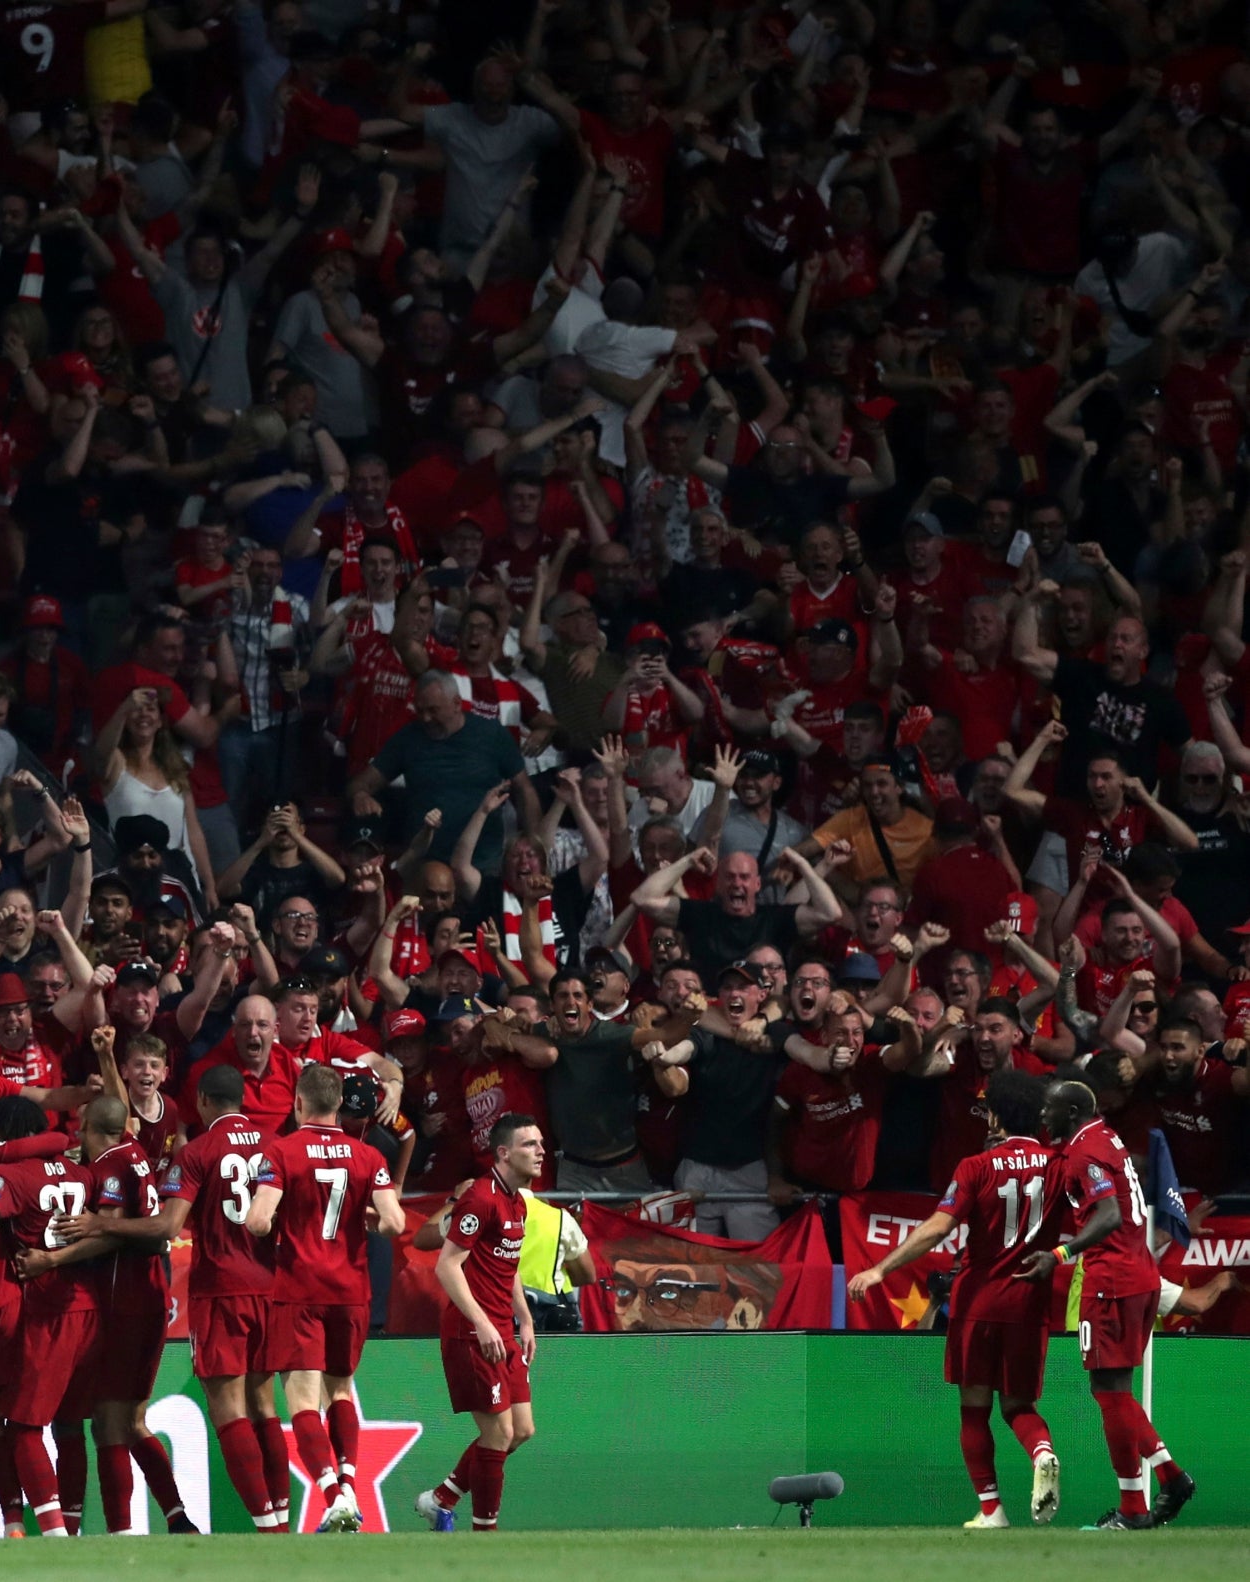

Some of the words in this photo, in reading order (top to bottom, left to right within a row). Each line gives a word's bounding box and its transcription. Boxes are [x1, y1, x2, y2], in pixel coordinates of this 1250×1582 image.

[20, 22, 56, 73] 9
[227, 1131, 262, 1147] MATIP
[306, 1143, 353, 1160] MILNER
[313, 1167, 349, 1242] 7
[997, 1175, 1045, 1249] 11
